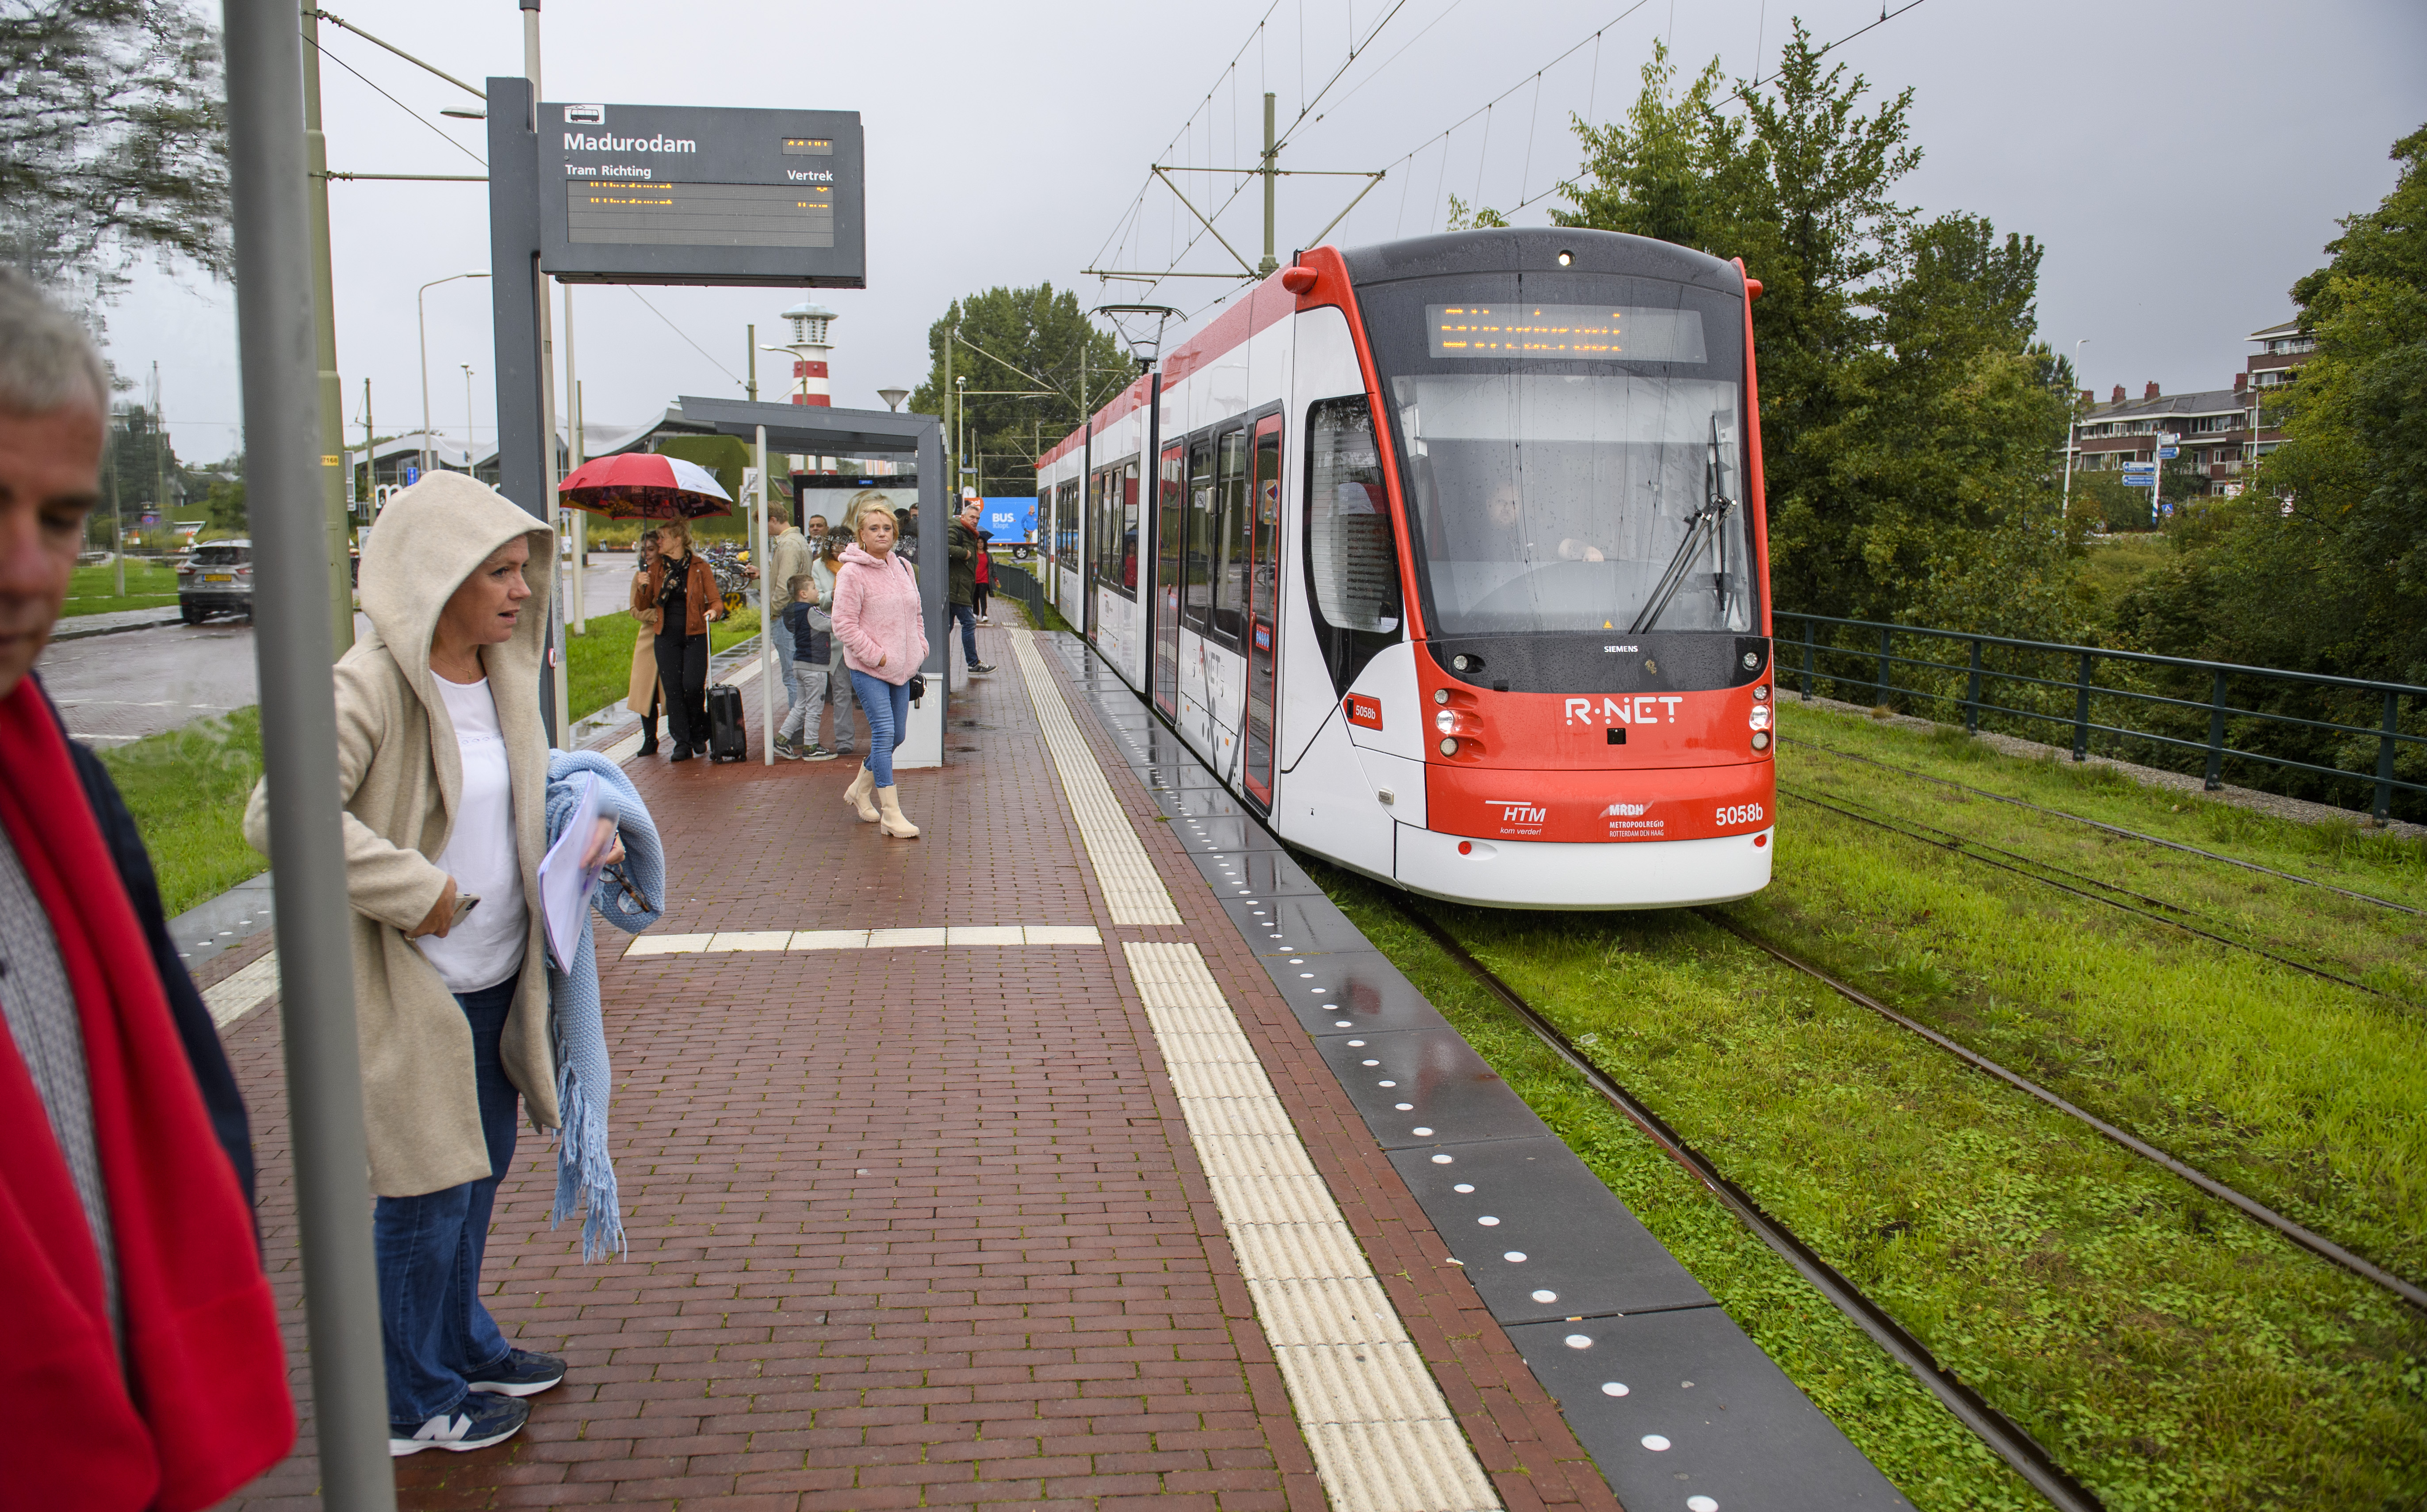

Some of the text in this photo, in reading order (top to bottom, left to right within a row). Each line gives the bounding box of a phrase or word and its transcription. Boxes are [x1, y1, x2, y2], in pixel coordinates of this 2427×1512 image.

[564, 132, 696, 153] Madurodam
[565, 164, 651, 179] Tram Richting
[787, 170, 834, 181] Vertrek
[1355, 705, 1376, 720] 5058b
[1504, 807, 1546, 822] HTM
[1609, 804, 1643, 816] MRDH
[1716, 802, 1763, 826] 5058b
